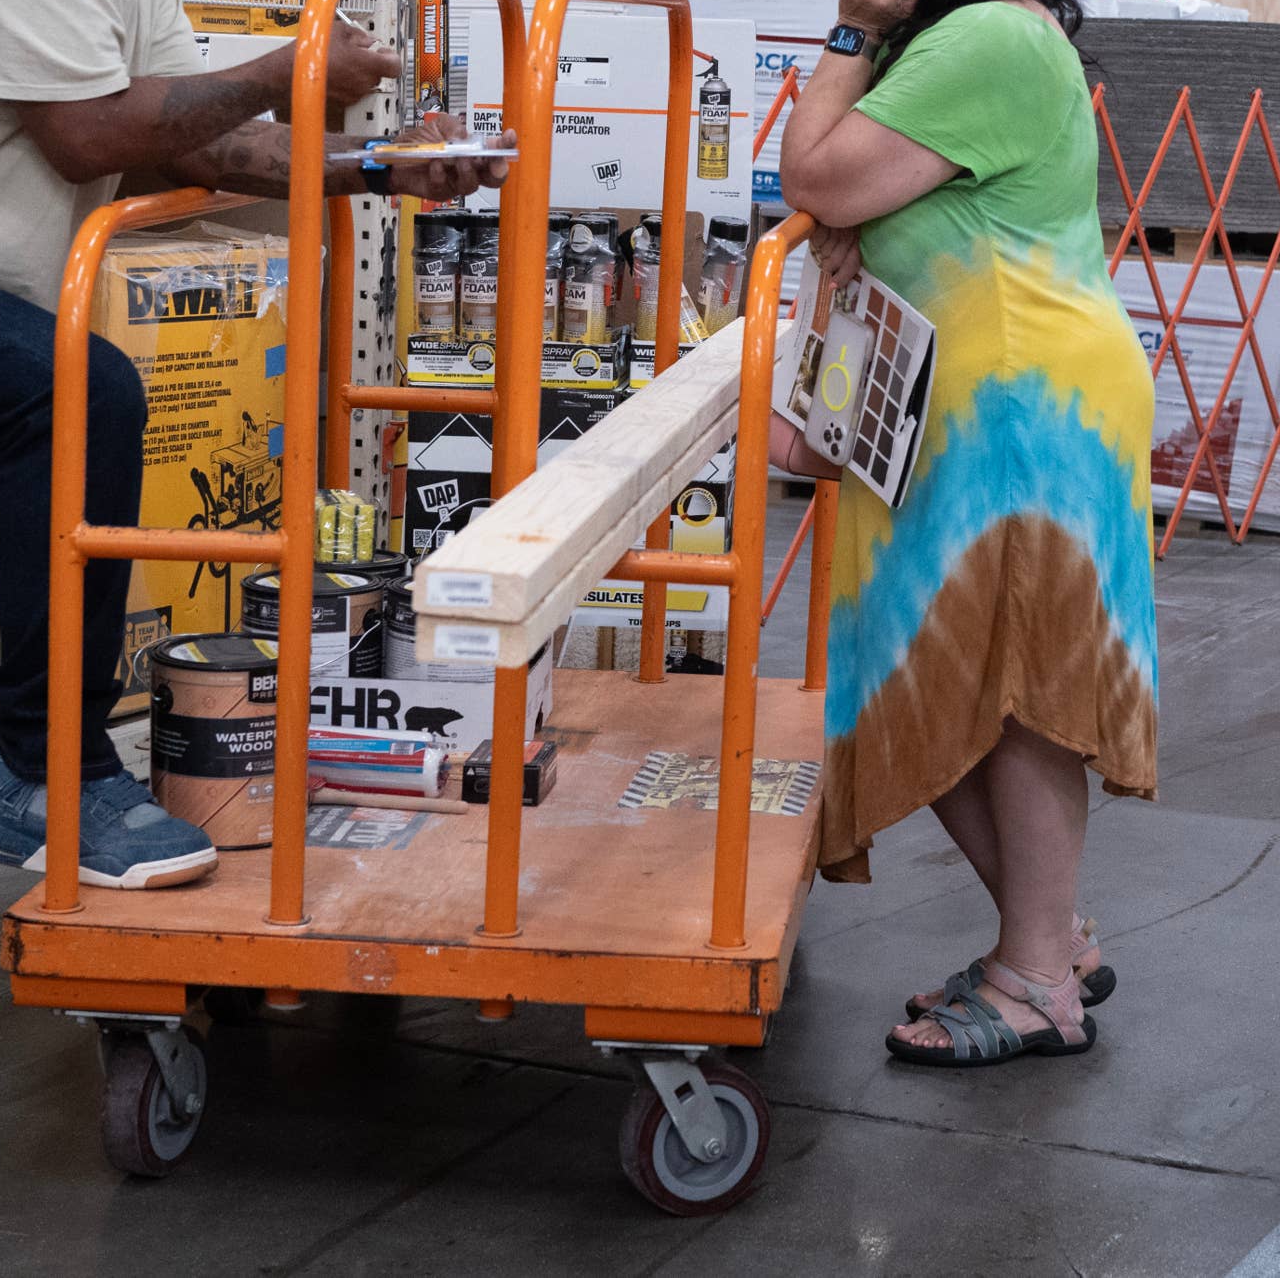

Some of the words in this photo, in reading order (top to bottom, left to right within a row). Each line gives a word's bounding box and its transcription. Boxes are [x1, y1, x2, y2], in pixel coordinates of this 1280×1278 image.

[424, 4, 437, 54] DRYWALL
[755, 52, 798, 70] OCK
[568, 116, 594, 125] FOAM
[474, 122, 496, 131] WITH
[555, 125, 610, 135] APPLICATOR
[596, 164, 619, 180] DAP
[428, 262, 442, 273] DAP
[472, 263, 485, 273] DAP
[419, 283, 453, 293] FOAM
[463, 284, 497, 293] FOAM
[128, 272, 256, 318] DEWALT
[564, 290, 586, 300] OAM
[156, 354, 174, 362] JOBSITE
[176, 352, 189, 360] TABLE
[201, 350, 212, 358] WITH
[543, 347, 574, 356] SPRAY
[166, 365, 174, 373] RIP
[174, 363, 195, 372] CAPACITY
[196, 362, 205, 370] AND
[207, 361, 224, 369] ROLLING
[225, 359, 238, 367] STAND
[148, 384, 163, 393] BANCO
[154, 394, 179, 402] CAPACIDAD
[187, 391, 201, 399] CORTE
[202, 388, 232, 398] LONGITUDINAL
[185, 402, 196, 410] BASE
[197, 400, 217, 408] RODANTE
[166, 424, 179, 432] TABLE
[188, 421, 209, 429] CHANTIER
[181, 433, 187, 441] UN
[203, 429, 222, 438] ROULANT
[162, 445, 168, 453] DE
[169, 443, 185, 452] SCIAGE
[422, 485, 456, 508] DAP
[583, 590, 644, 603] SULATES
[138, 625, 155, 635] TEAM
[139, 635, 153, 645] LIFT
[253, 675, 277, 692] BEH
[216, 729, 276, 743] WATERP
[229, 741, 273, 753] WOOD
[245, 762, 253, 772] 4
